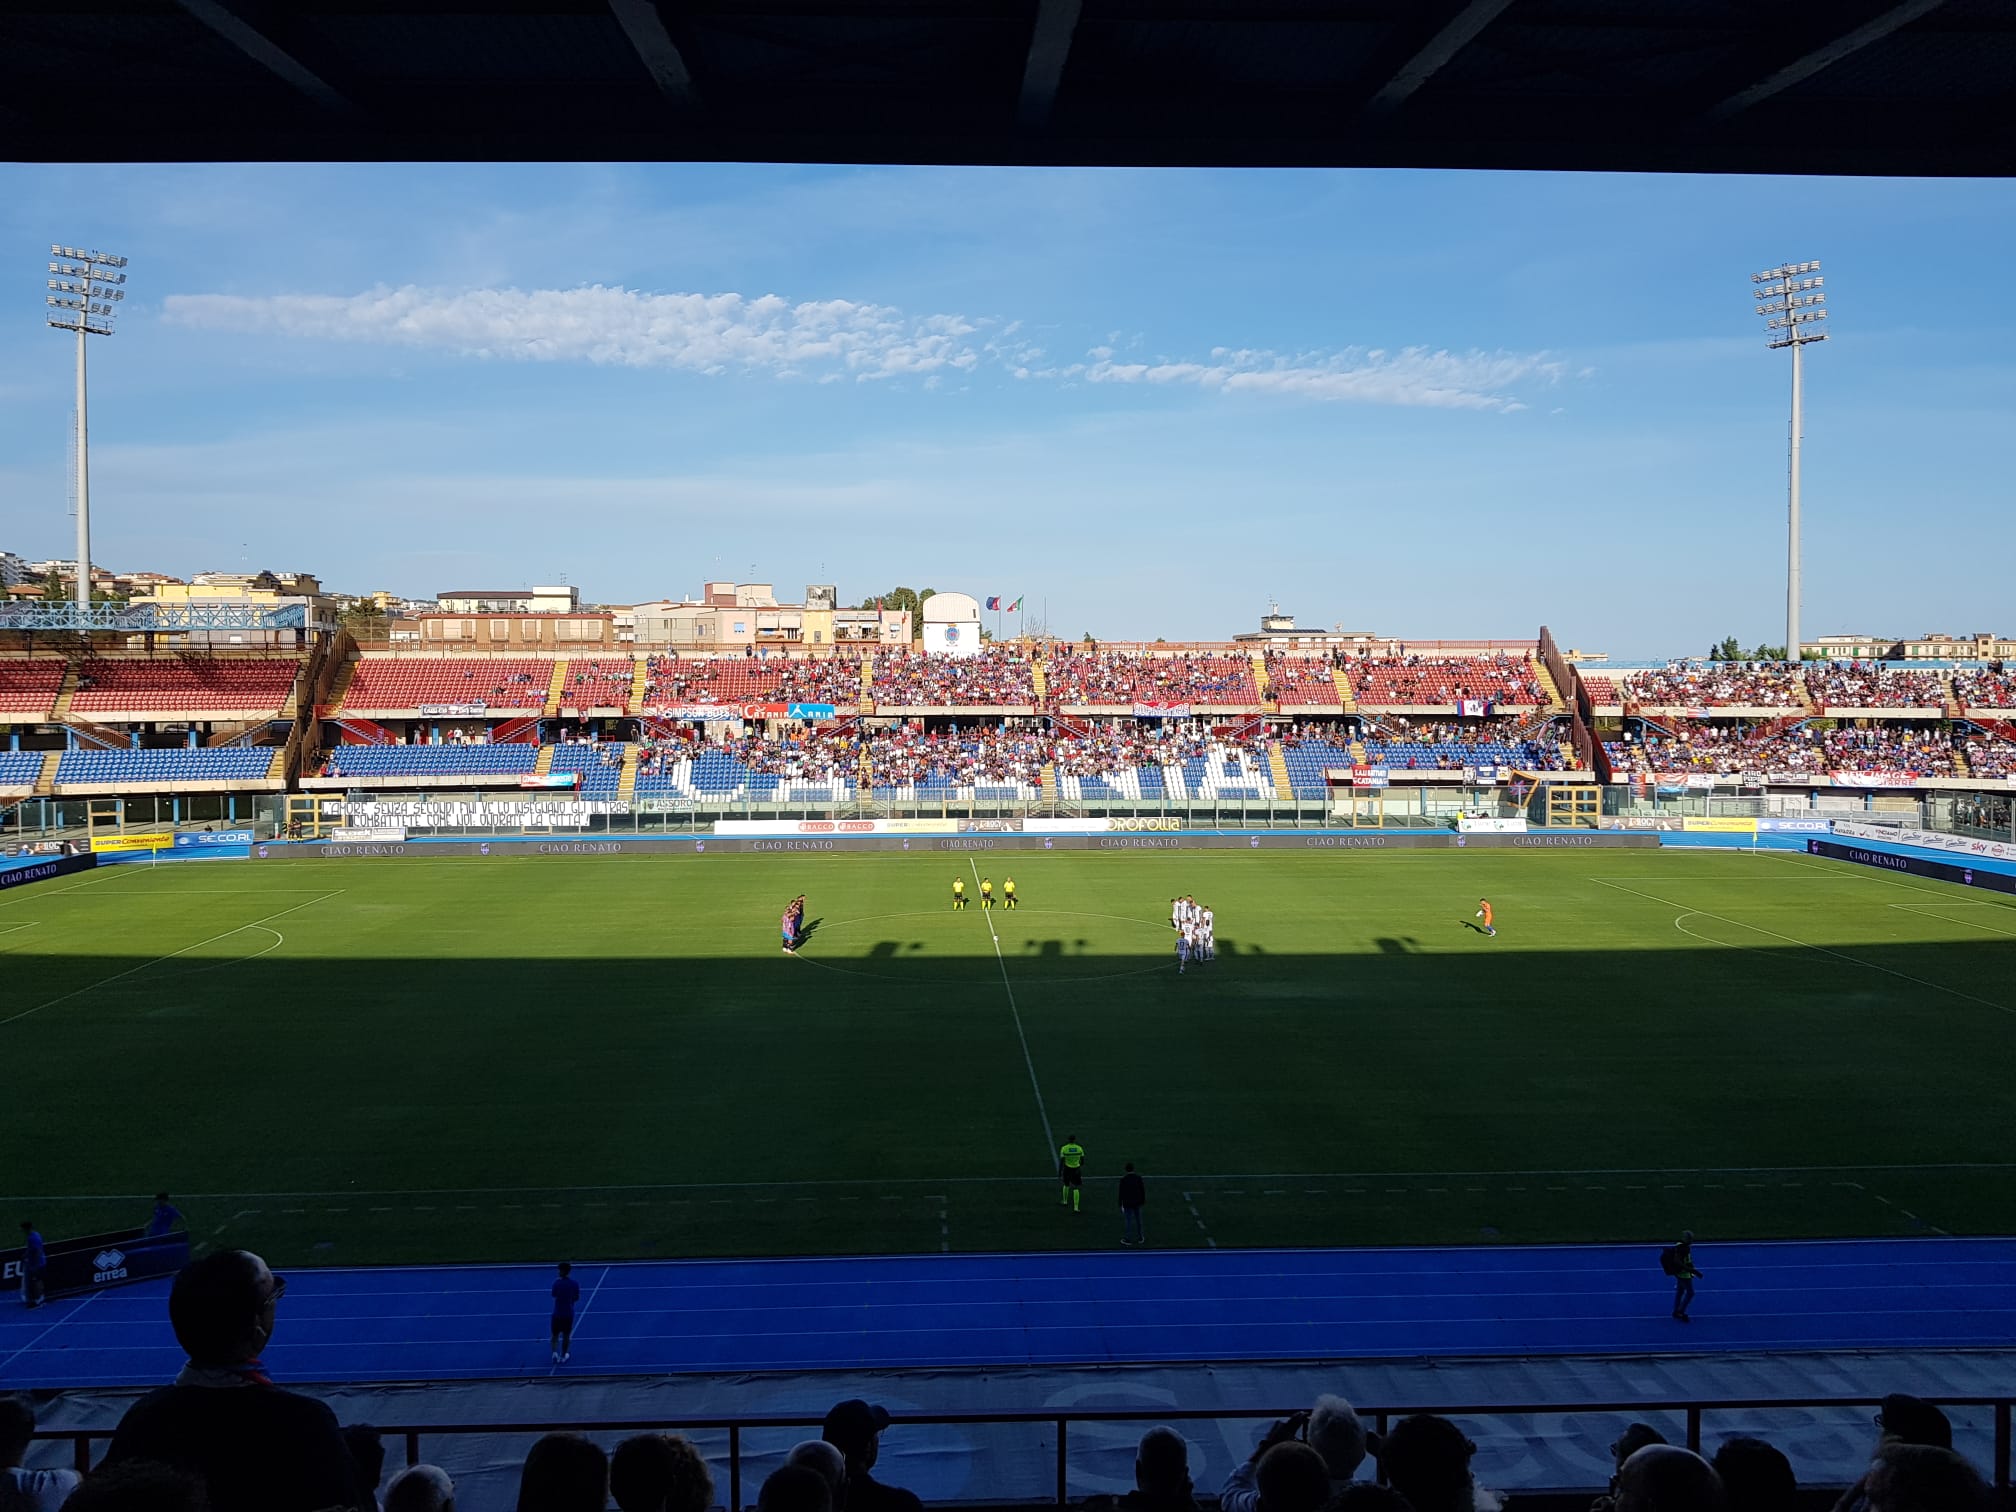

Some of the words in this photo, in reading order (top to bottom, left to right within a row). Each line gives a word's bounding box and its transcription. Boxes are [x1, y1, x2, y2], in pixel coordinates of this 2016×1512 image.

[374, 801, 408, 815] SENZA
[413, 801, 455, 815] SECONDI
[460, 801, 478, 815] FINI
[483, 801, 494, 814] VE
[499, 801, 510, 814] LO
[514, 801, 566, 815] INSEGNANO
[571, 801, 587, 814] GLI
[591, 800, 629, 814] ULTRAS
[656, 799, 693, 808] ASSORO
[353, 814, 421, 828] COMBATTETE
[427, 814, 451, 827] COME
[479, 813, 524, 827] ONORATE
[530, 813, 543, 827] LA
[753, 841, 782, 850] CIAO
[787, 840, 833, 850] RENATO
[940, 839, 960, 849] CIAO
[963, 839, 994, 848] RENATO
[1100, 839, 1128, 848] CIAO
[1133, 838, 1178, 847] RENATO
[1306, 837, 1335, 846] CIAO
[1339, 837, 1385, 846] RENATO
[1513, 837, 1541, 846] CIAO
[1546, 836, 1593, 845] RENATO
[320, 846, 351, 856] CIAO
[356, 845, 405, 855] RENATO
[539, 844, 569, 853] CIAO
[574, 843, 622, 852] RENATO
[1971, 841, 1988, 854] sky
[1849, 849, 1870, 862] CIAO
[1872, 854, 1907, 869] RENATO
[1, 871, 22, 885] CIAO
[24, 864, 57, 880] RENATO
[93, 1267, 128, 1283] errea
